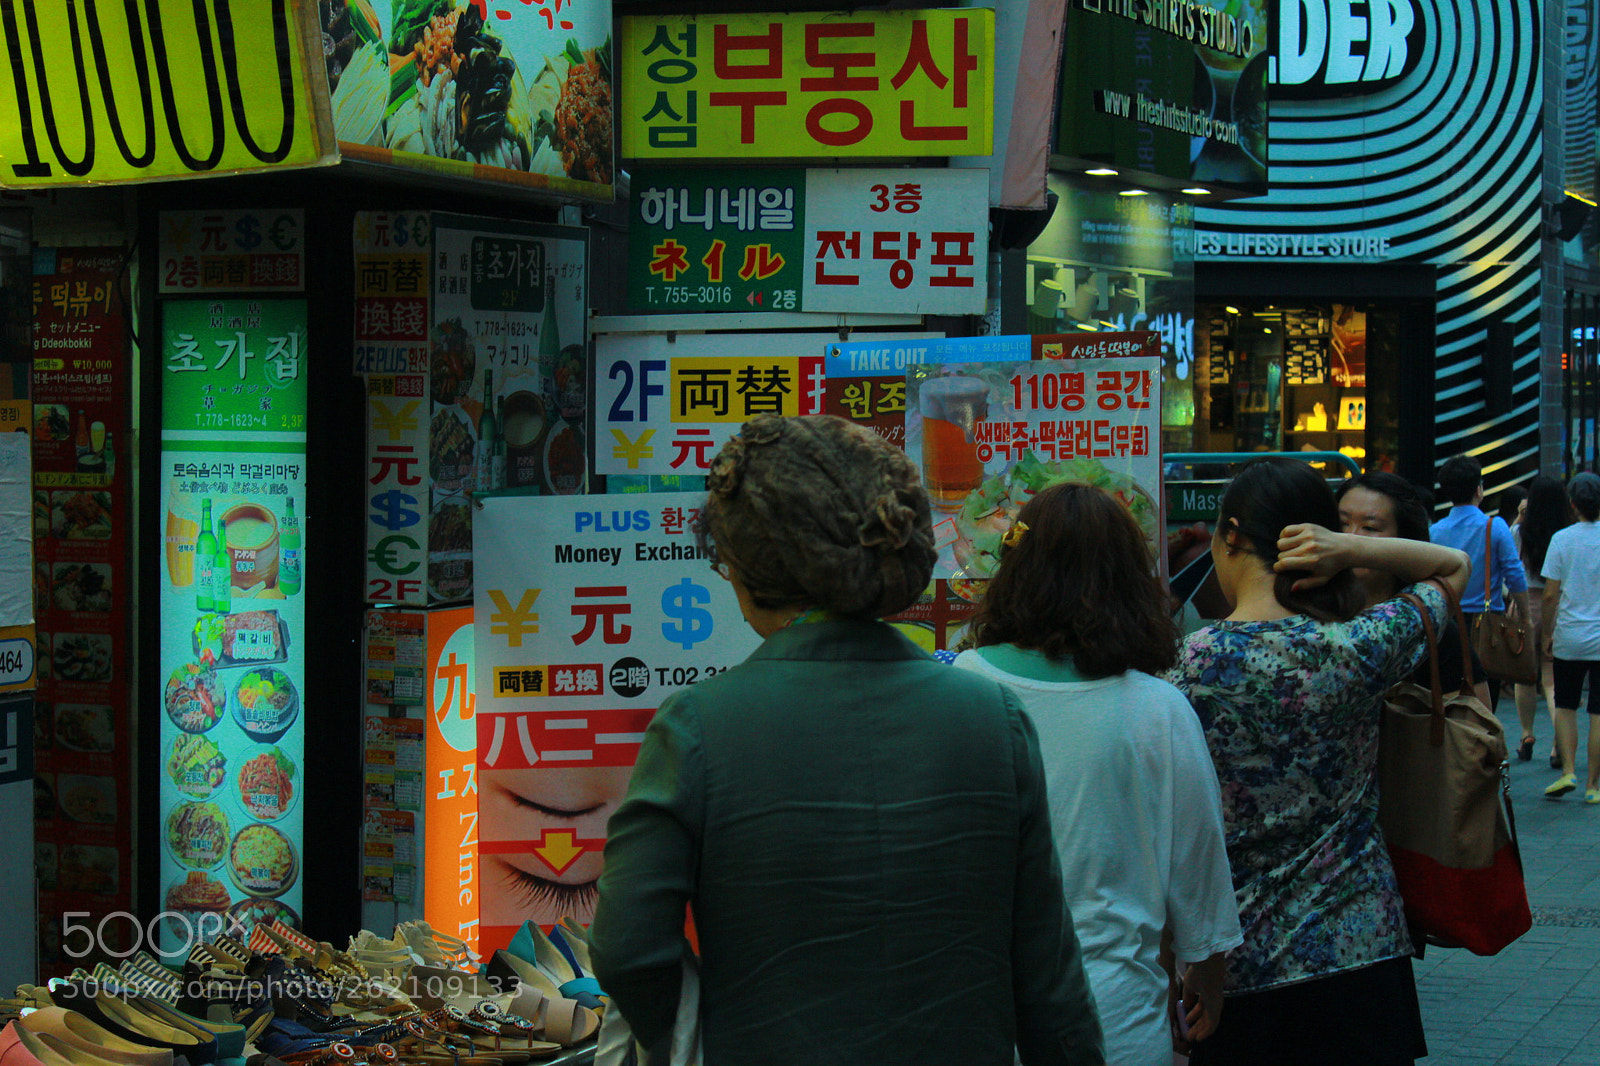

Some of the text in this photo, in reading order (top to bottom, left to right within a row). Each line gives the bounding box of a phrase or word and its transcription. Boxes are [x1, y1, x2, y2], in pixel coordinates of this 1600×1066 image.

[1143, 0, 1195, 41] SHIRTS
[1200, 7, 1253, 59] STUDIO
[641, 24, 698, 149] 성심
[709, 17, 978, 147] 부동산
[640, 187, 794, 231] 하니네일
[869, 183, 922, 214] 3층
[488, 243, 542, 288] 초가집
[648, 238, 786, 283] ネイル
[815, 230, 975, 289] 전당포
[1226, 233, 1325, 257] LIFESTYLE
[1328, 236, 1390, 258] STORE
[165, 256, 200, 287] 2층
[204, 258, 248, 284] 両替
[360, 258, 423, 293] 両替
[51, 280, 113, 318] 떡볶이
[772, 289, 796, 309] 2층
[41, 338, 92, 349] Ddeokbokki
[167, 331, 299, 380] 초가집
[487, 344, 531, 366] マッコリ
[849, 349, 892, 371] TAKE
[894, 347, 928, 370] OUT
[607, 359, 667, 422] 2F
[677, 365, 792, 417] 両替
[1008, 370, 1152, 412] 110평 공간
[173, 462, 300, 480] 토속음식과 막걸리마당
[370, 445, 422, 486] 元
[369, 490, 421, 531] $
[575, 509, 651, 533] PLUS
[367, 535, 422, 575] €
[555, 544, 622, 566] Money
[368, 579, 422, 600] 2F
[571, 586, 632, 647] 元
[661, 577, 714, 650] $
[436, 652, 476, 725] 九
[498, 669, 544, 694] 両替
[611, 667, 649, 689] 2階
